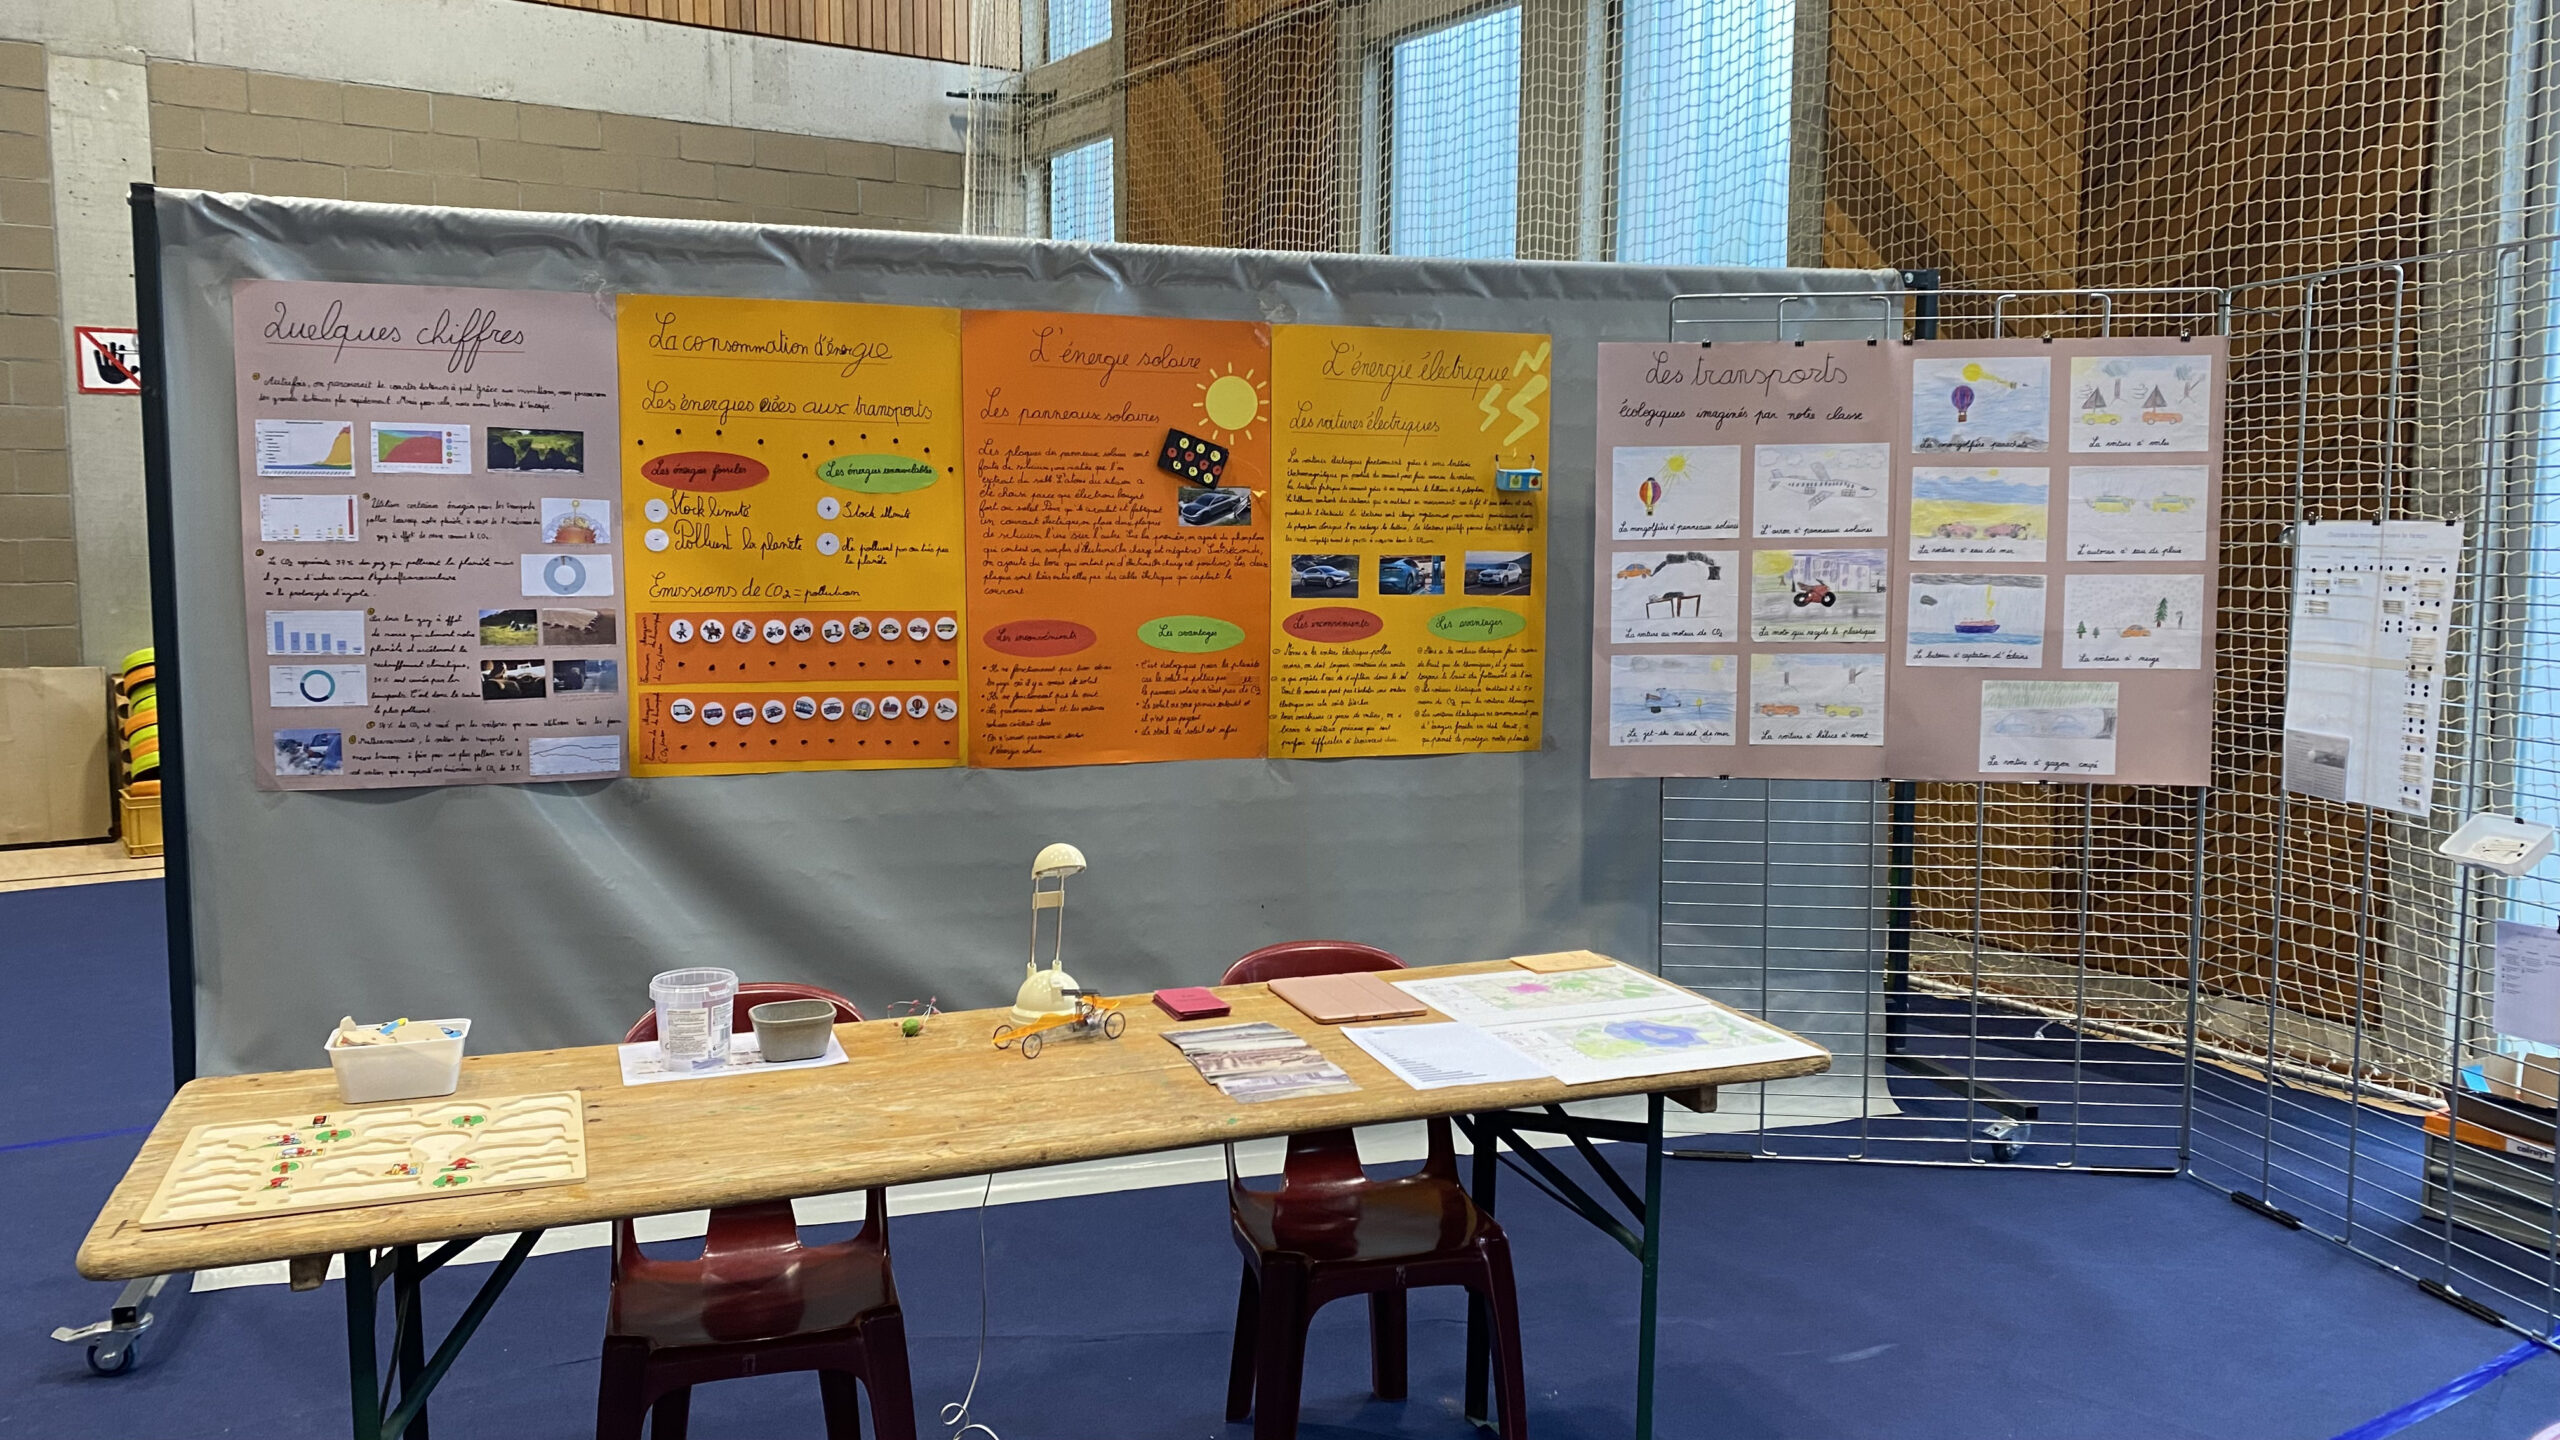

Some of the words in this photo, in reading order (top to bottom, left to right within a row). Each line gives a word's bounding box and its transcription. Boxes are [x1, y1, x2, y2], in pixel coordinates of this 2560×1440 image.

[264, 300, 401, 363] Quelques
[416, 308, 524, 373] chiffres
[649, 312, 676, 350] La
[683, 330, 808, 356] consommation
[814, 334, 892, 378] d'énergie
[1030, 326, 1128, 387] L'énergie
[1137, 344, 1200, 369] solaire
[1323, 340, 1412, 401] L'énergie
[1418, 350, 1510, 400] électrique
[1646, 351, 1683, 384] Les
[1691, 352, 1847, 397] transports
[642, 380, 676, 410] Les
[679, 393, 755, 425] énergies
[802, 401, 849, 414] aux
[853, 395, 933, 426] transports
[981, 387, 1009, 419] Les
[1018, 407, 1101, 426] panneaux
[1104, 402, 1160, 423] solaires
[1619, 399, 1685, 427] écologiques
[1696, 407, 1748, 427] imaginés
[1754, 409, 1778, 425] par
[1289, 400, 1313, 429] Les
[1317, 410, 1363, 430] voitures
[1367, 406, 1440, 447] électriques
[978, 439, 999, 457] Les
[651, 459, 669, 475] Les
[826, 461, 844, 477] Les
[670, 489, 705, 518] Stock
[709, 497, 751, 518] limité
[842, 501, 876, 518] Stock
[674, 518, 733, 550] Polluent
[760, 532, 802, 560] planète
[649, 571, 737, 599] Emissions
[742, 578, 761, 597] de
[805, 585, 861, 603] pollution
[1159, 624, 1173, 637] Les
[1759, 626, 1768, 636] La
